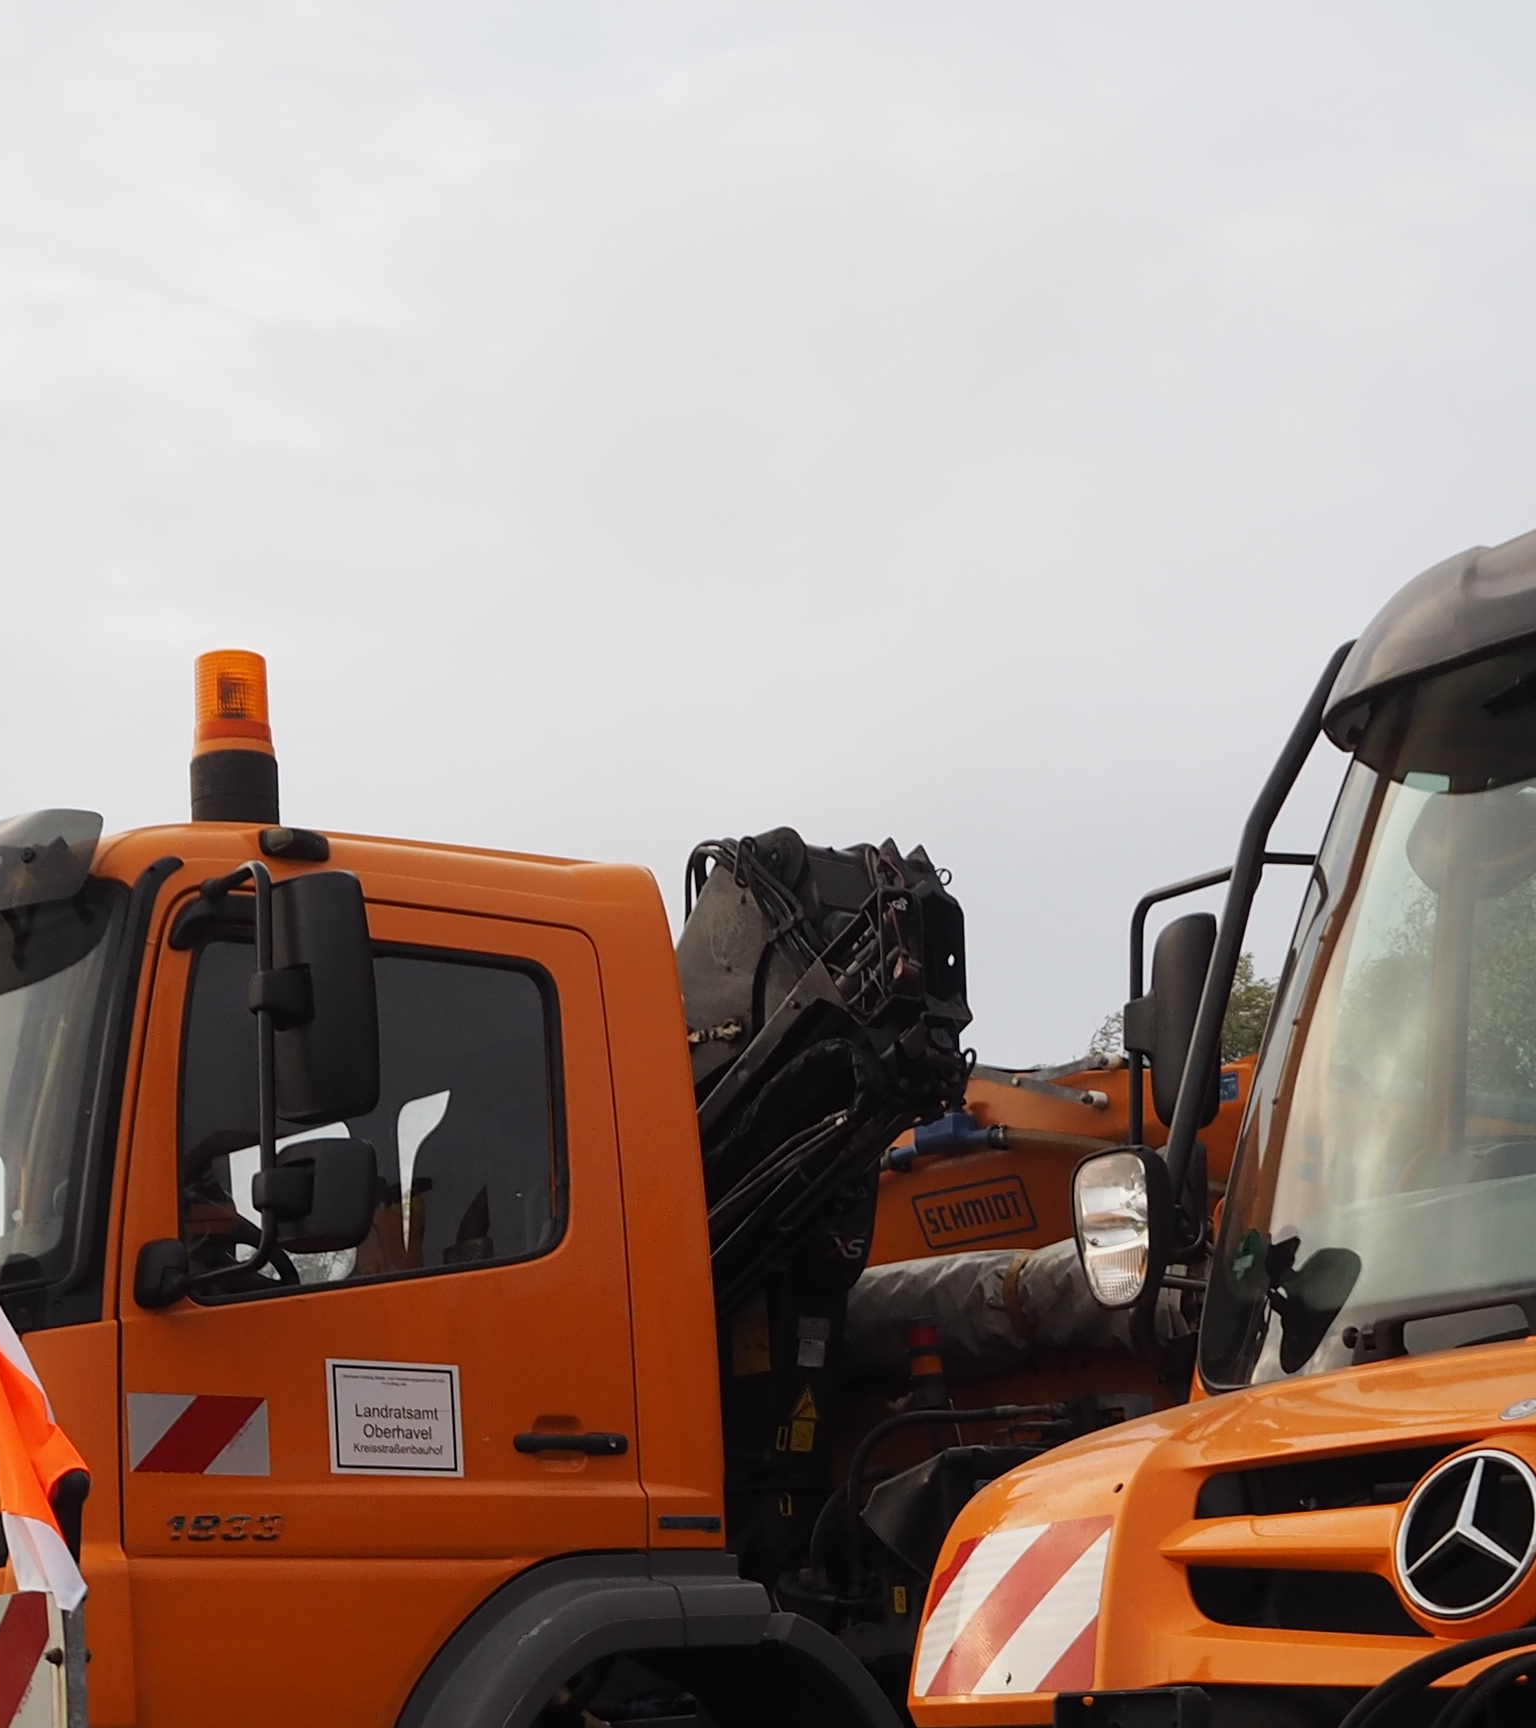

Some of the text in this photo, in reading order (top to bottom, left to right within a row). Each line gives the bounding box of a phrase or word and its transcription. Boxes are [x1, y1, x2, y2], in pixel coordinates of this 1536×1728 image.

[924, 1191, 1023, 1234] SCHMIDT
[354, 1403, 439, 1421] Landratsamt
[363, 1423, 433, 1440] Oberhavel
[353, 1442, 444, 1456] Kreisstraßenbauhof
[166, 1514, 284, 1542] 1833
